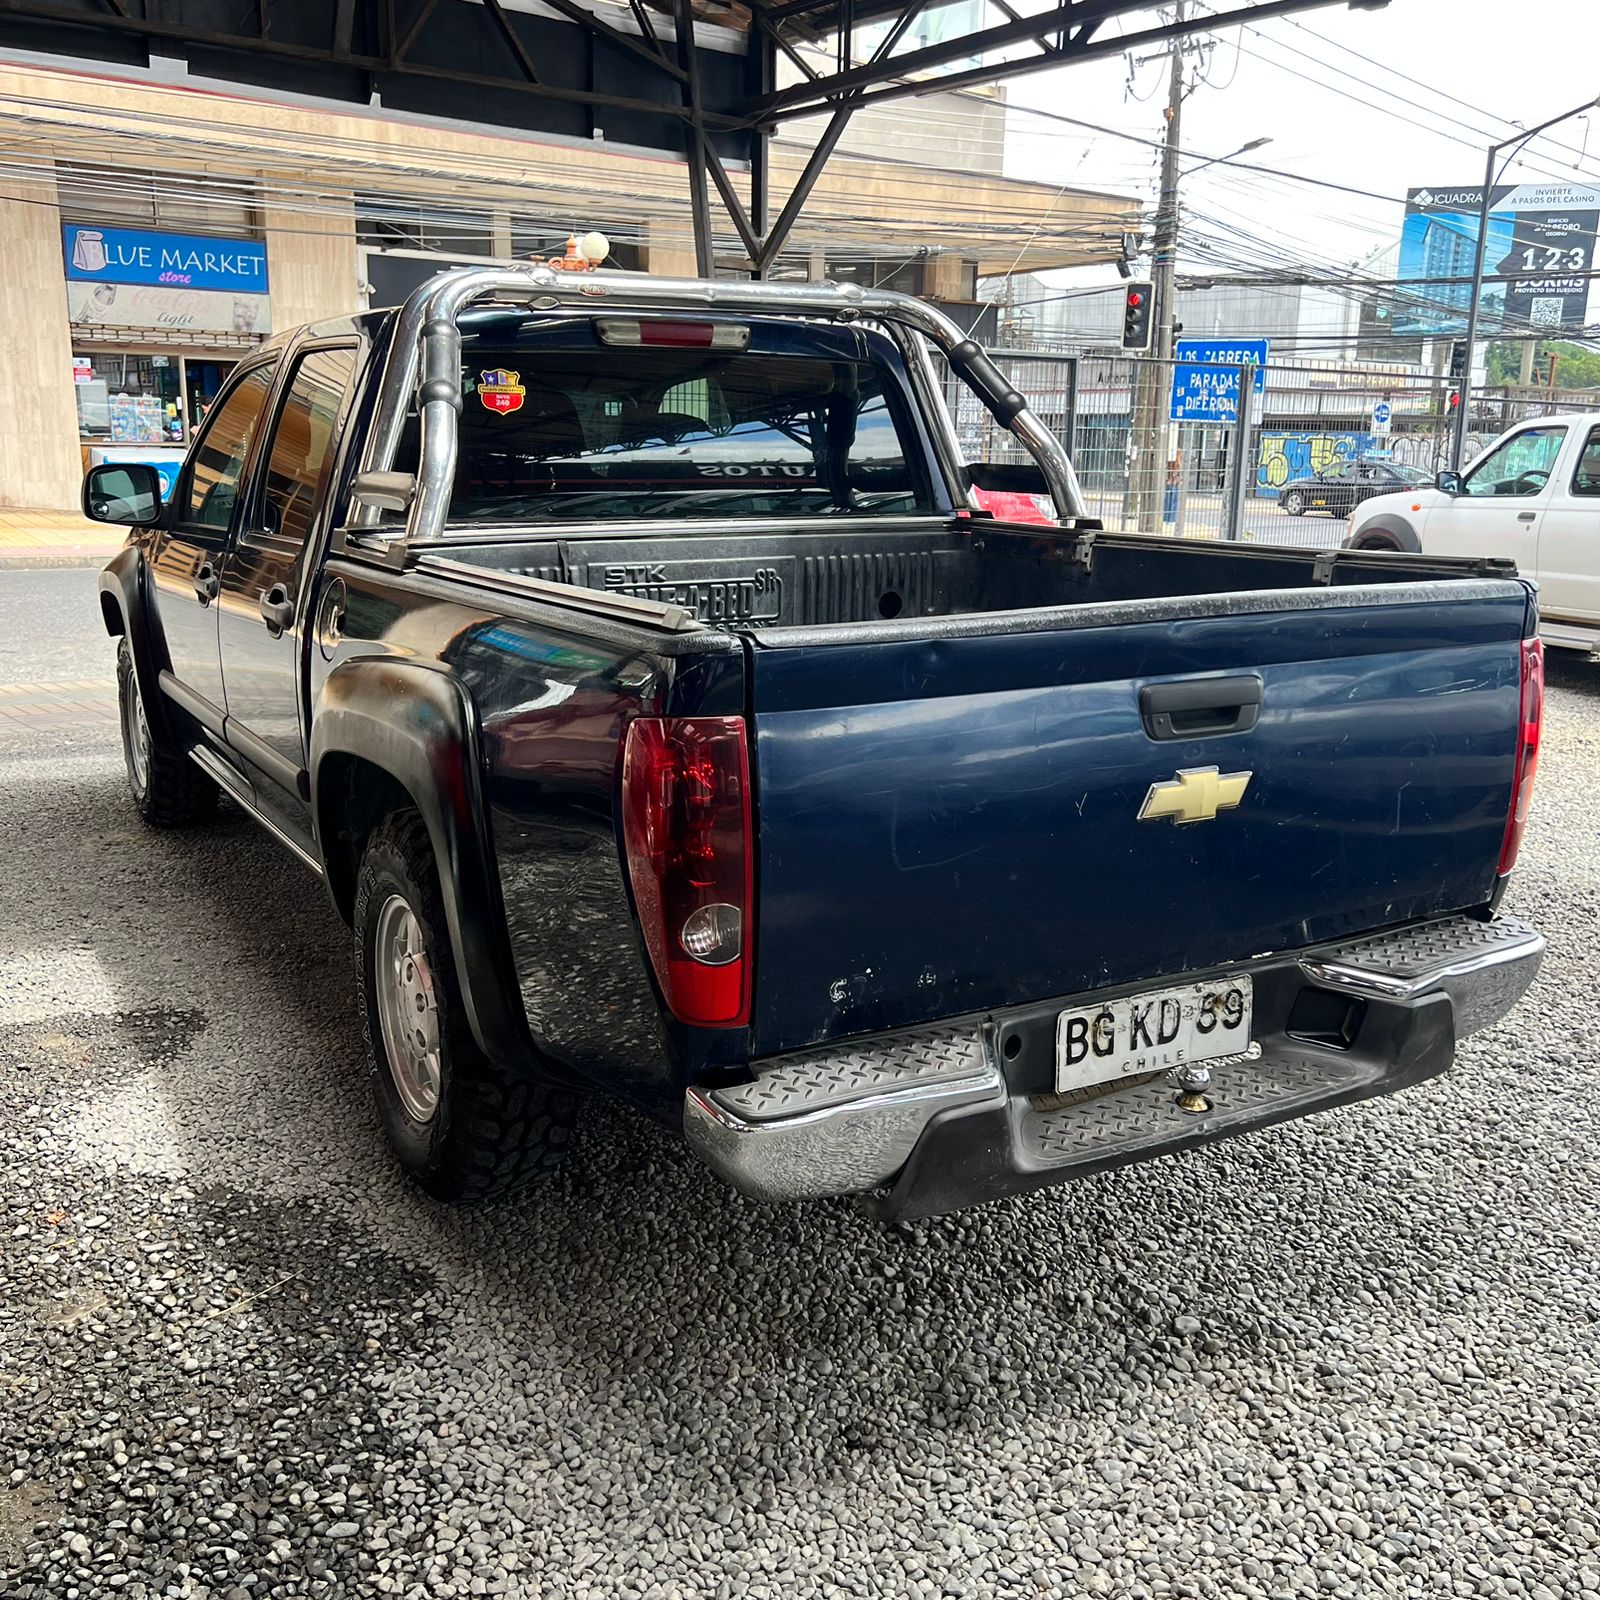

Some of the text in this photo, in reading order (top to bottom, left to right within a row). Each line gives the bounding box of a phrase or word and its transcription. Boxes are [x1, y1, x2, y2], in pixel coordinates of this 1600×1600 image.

[1434, 193, 1483, 205] ICUADRA
[1535, 188, 1572, 196] INVIERTE
[1546, 196, 1560, 204] DEL
[1563, 195, 1595, 203] CASINO
[160, 248, 265, 276] MARKET
[159, 271, 192, 284] store
[1190, 373, 1240, 389] PARADAS
[1185, 396, 1239, 412] DIFERIDA
[604, 564, 667, 584] STK
[1066, 1011, 1115, 1066] BG
[1130, 996, 1181, 1051] KD
[1121, 1049, 1185, 1073] CHILE
